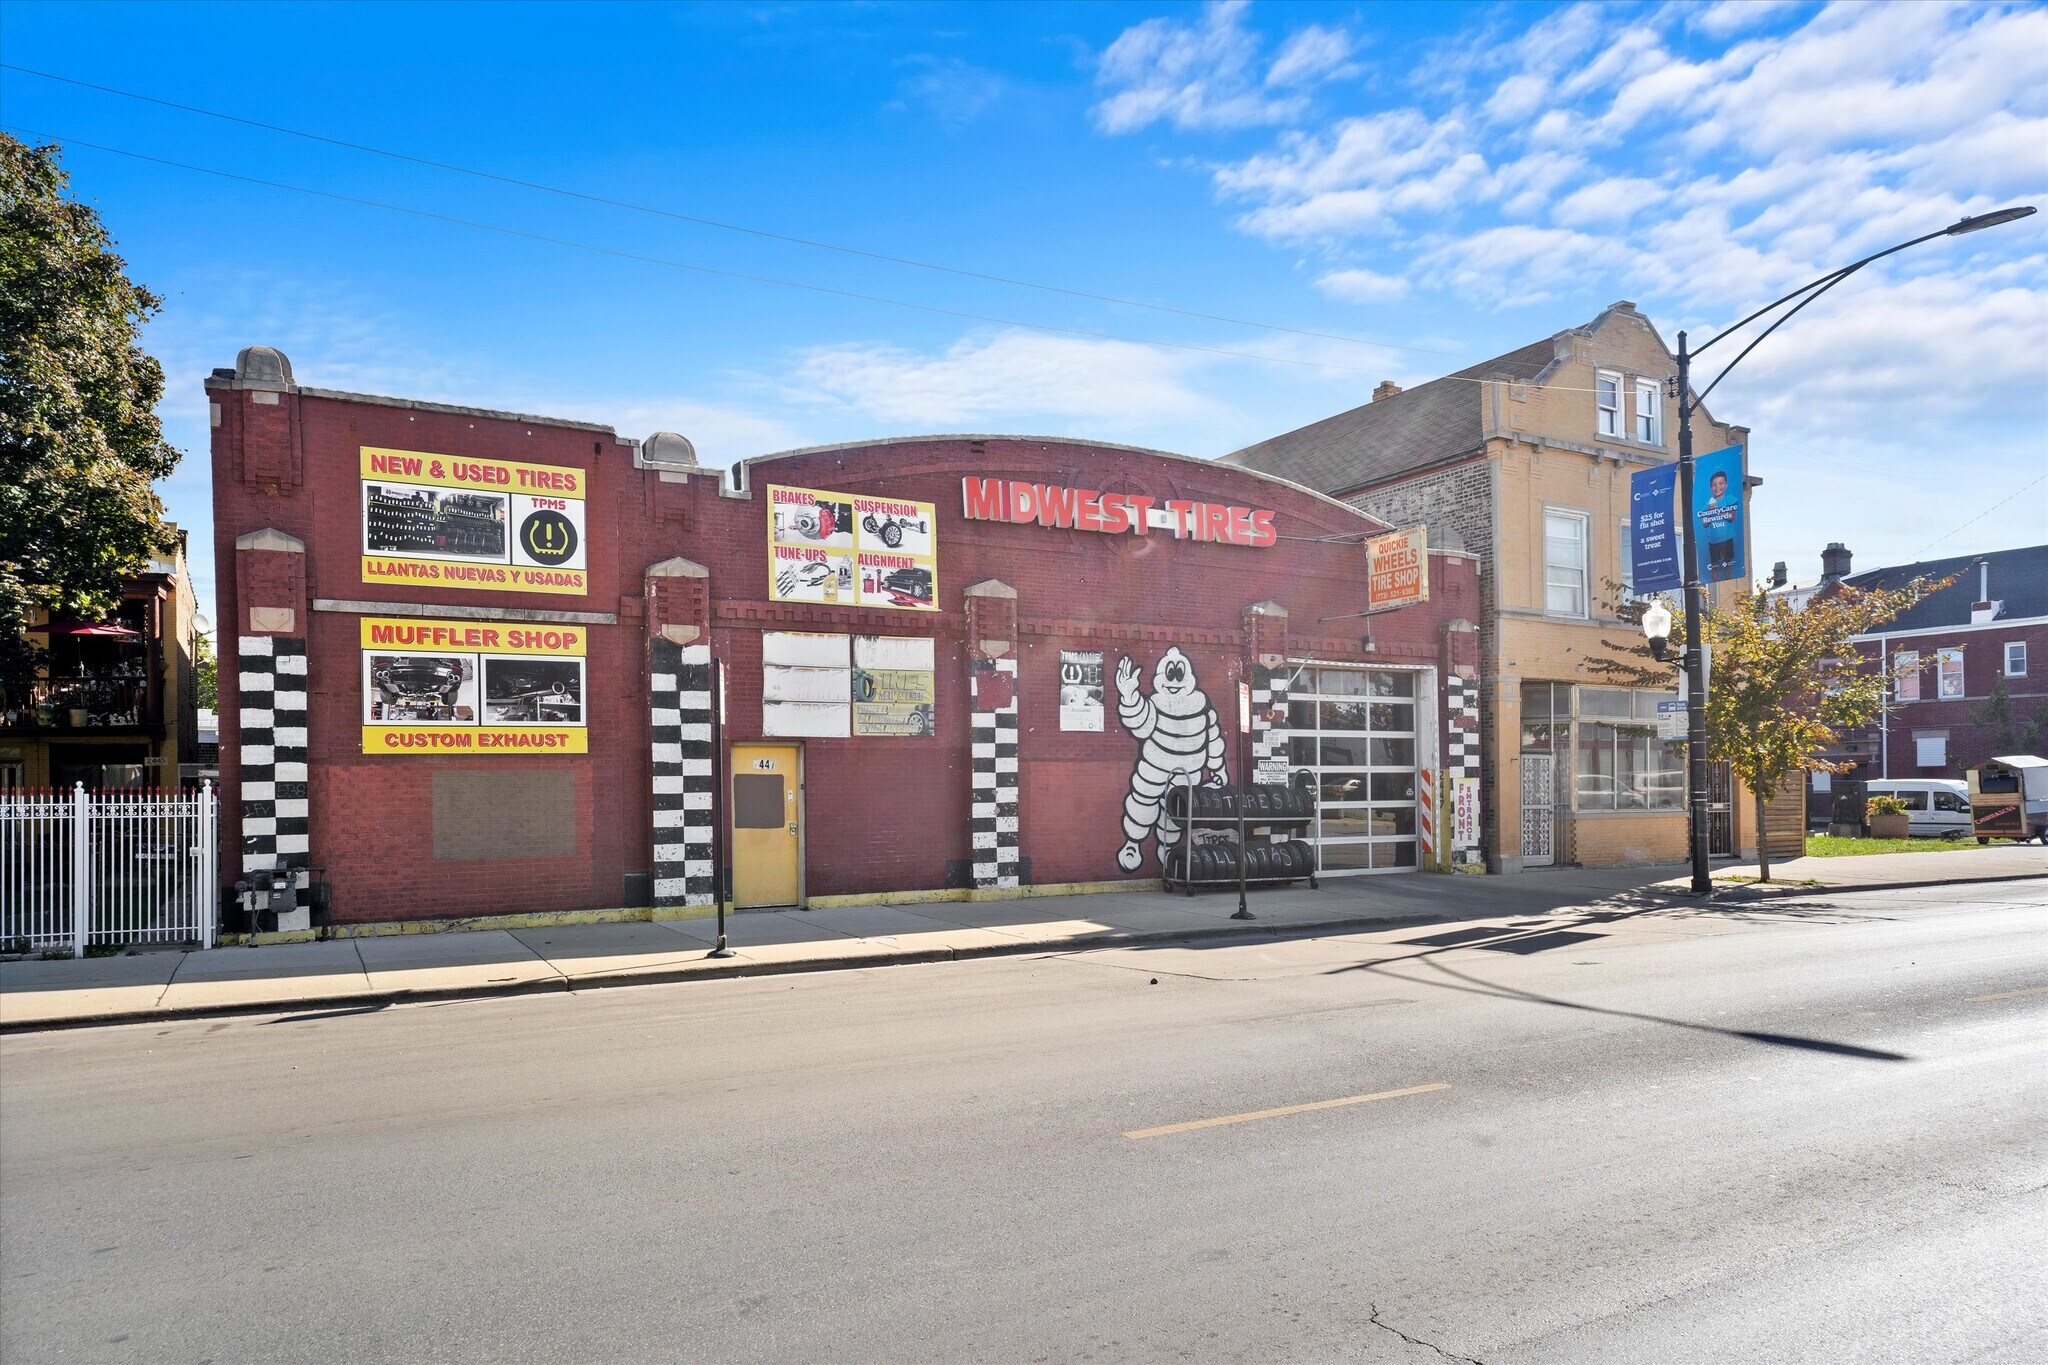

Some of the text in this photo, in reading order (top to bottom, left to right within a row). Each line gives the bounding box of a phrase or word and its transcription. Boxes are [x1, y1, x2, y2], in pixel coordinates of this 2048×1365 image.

[370, 454, 578, 492] NEW & USED TIRES
[531, 497, 567, 511] TPMS
[772, 489, 815, 506] BRAKES
[853, 499, 918, 517] SUSPENSION
[962, 475, 1277, 547] MIDWEST TIRES
[1697, 504, 1738, 518] CountyCare
[1639, 518, 1665, 530] flu shot
[1640, 511, 1665, 522] $25 for
[1702, 512, 1732, 524] Rewards
[1712, 521, 1725, 529] You
[1646, 533, 1666, 541] sweet
[1379, 537, 1408, 554] QUICKIE
[1644, 541, 1662, 550] treat
[773, 545, 828, 563] TUNE-UPS
[857, 553, 915, 569] ALIGNMENT
[1374, 548, 1417, 572] WHEELS
[366, 561, 583, 588] LLANTAS NUEVAS Y USADAS
[1372, 568, 1419, 591] TIRE SHOP
[371, 624, 578, 649] MUFFLER SHOP
[384, 733, 570, 748] CUSTOM EXHAUST
[1259, 761, 1287, 772] WARNING
